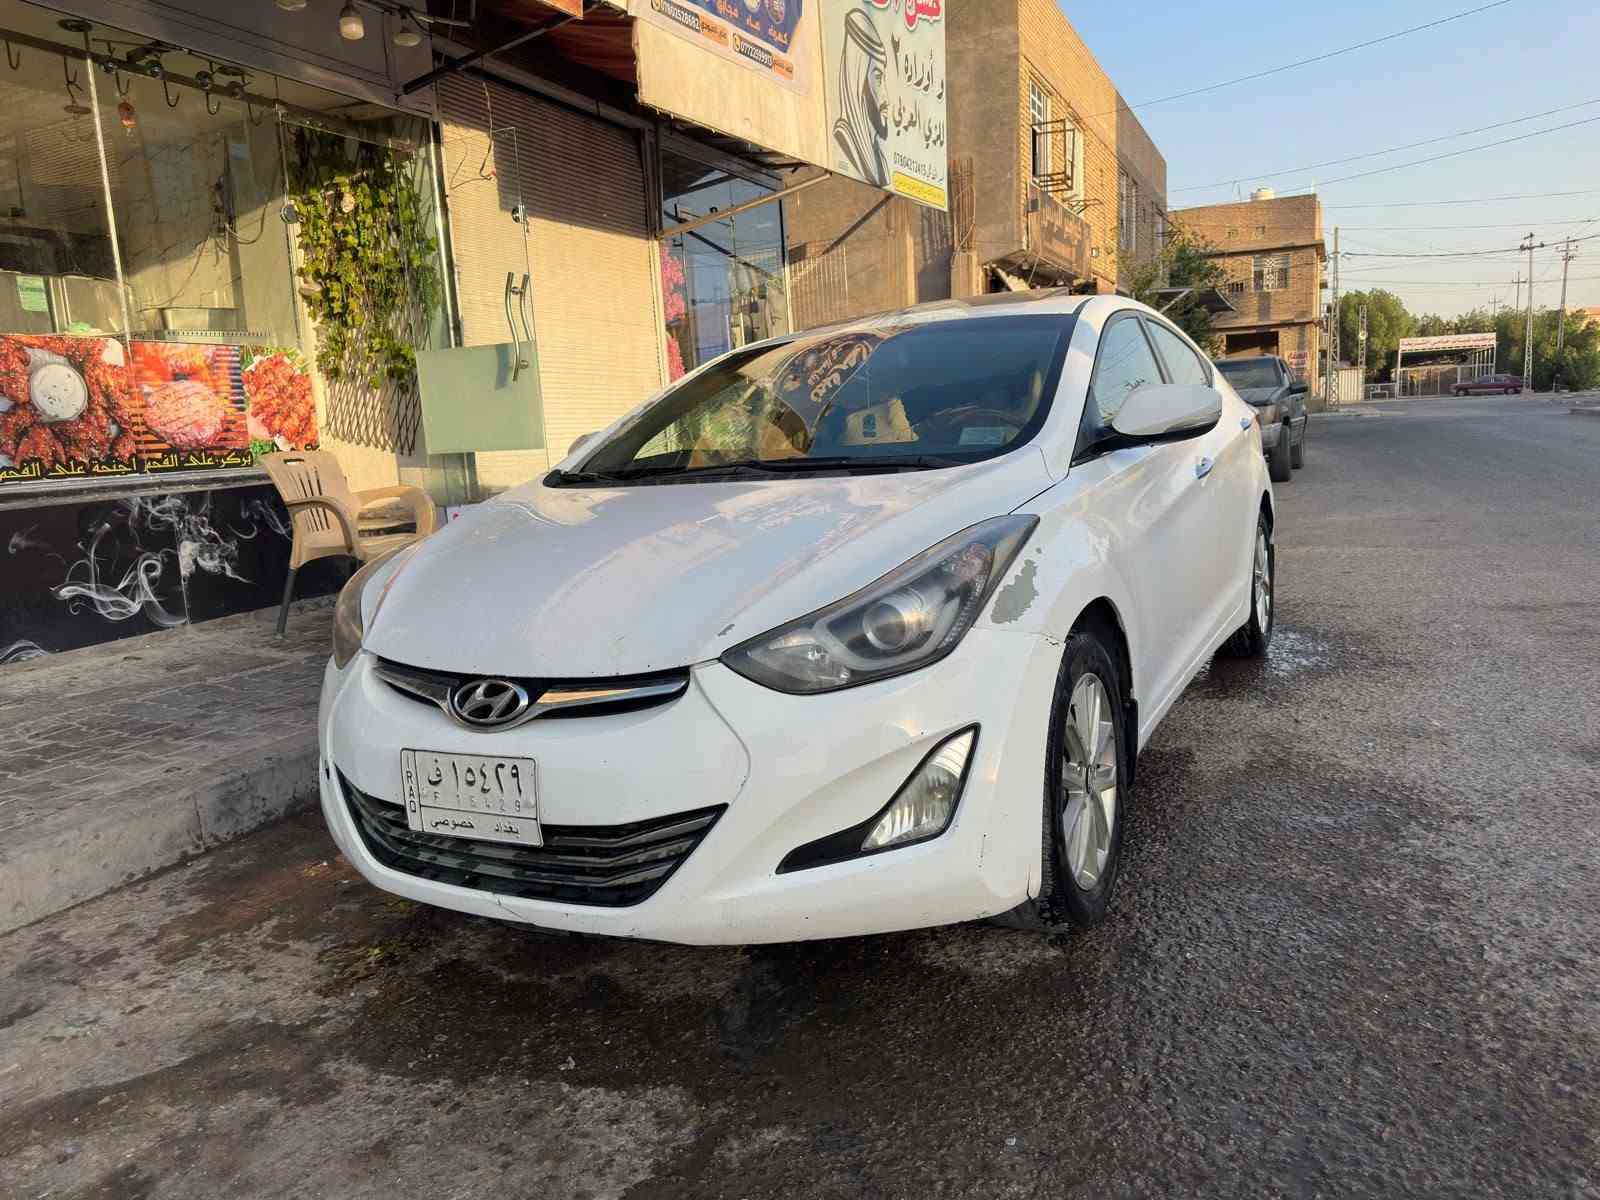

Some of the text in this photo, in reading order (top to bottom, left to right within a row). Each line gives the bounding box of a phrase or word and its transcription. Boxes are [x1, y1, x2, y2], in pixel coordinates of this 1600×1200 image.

[93, 456, 137, 474] اجنحة
[144, 454, 178, 474] الفحم
[430, 815, 475, 831] خصوصي
